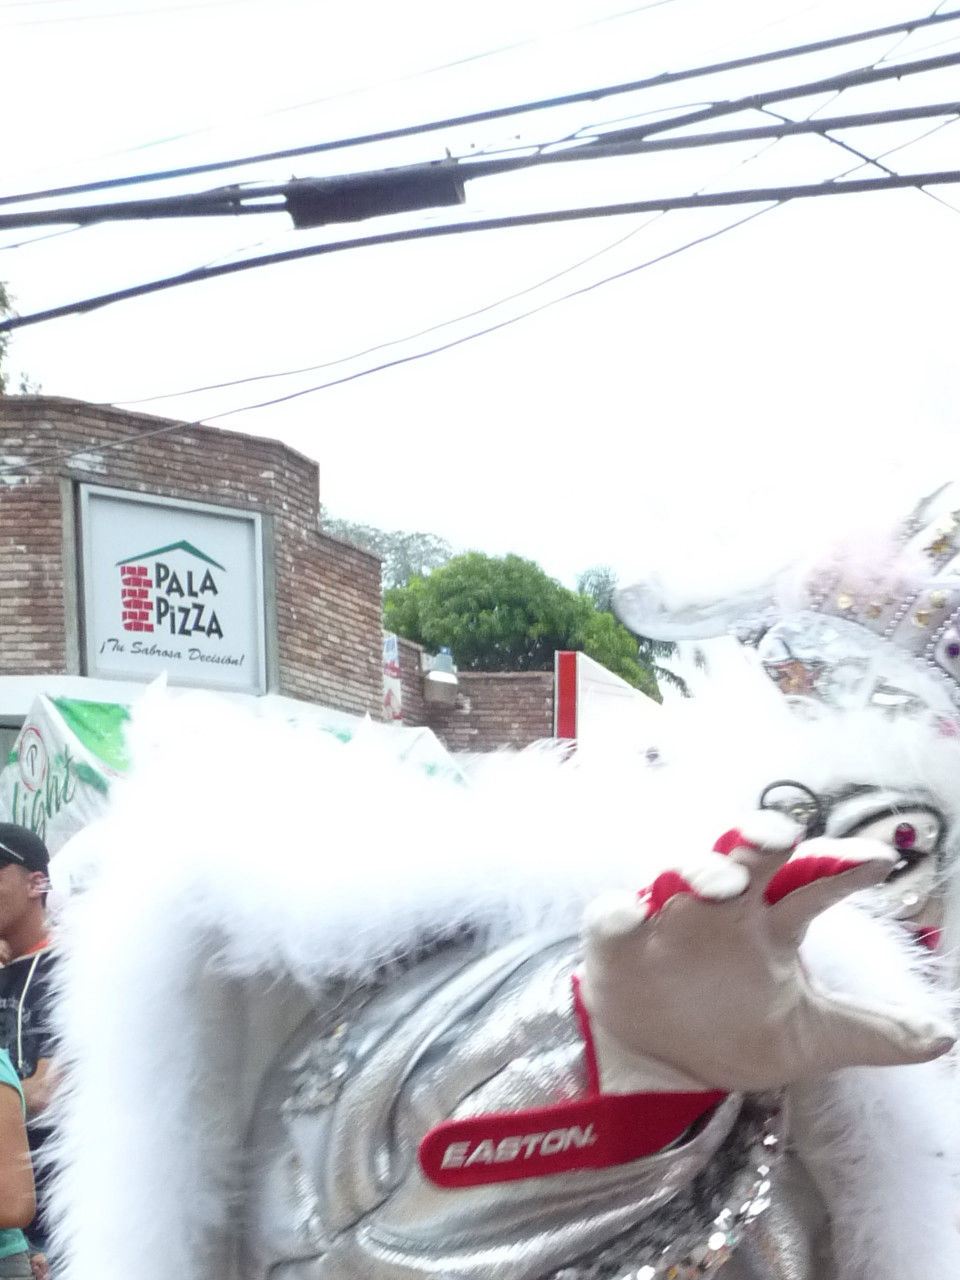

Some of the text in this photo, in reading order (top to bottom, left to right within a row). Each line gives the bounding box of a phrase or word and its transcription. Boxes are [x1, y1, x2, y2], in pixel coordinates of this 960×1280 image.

[154, 562, 219, 598] PALA
[130, 641, 182, 660] Sabrosa
[440, 1124, 594, 1170] EASTON
